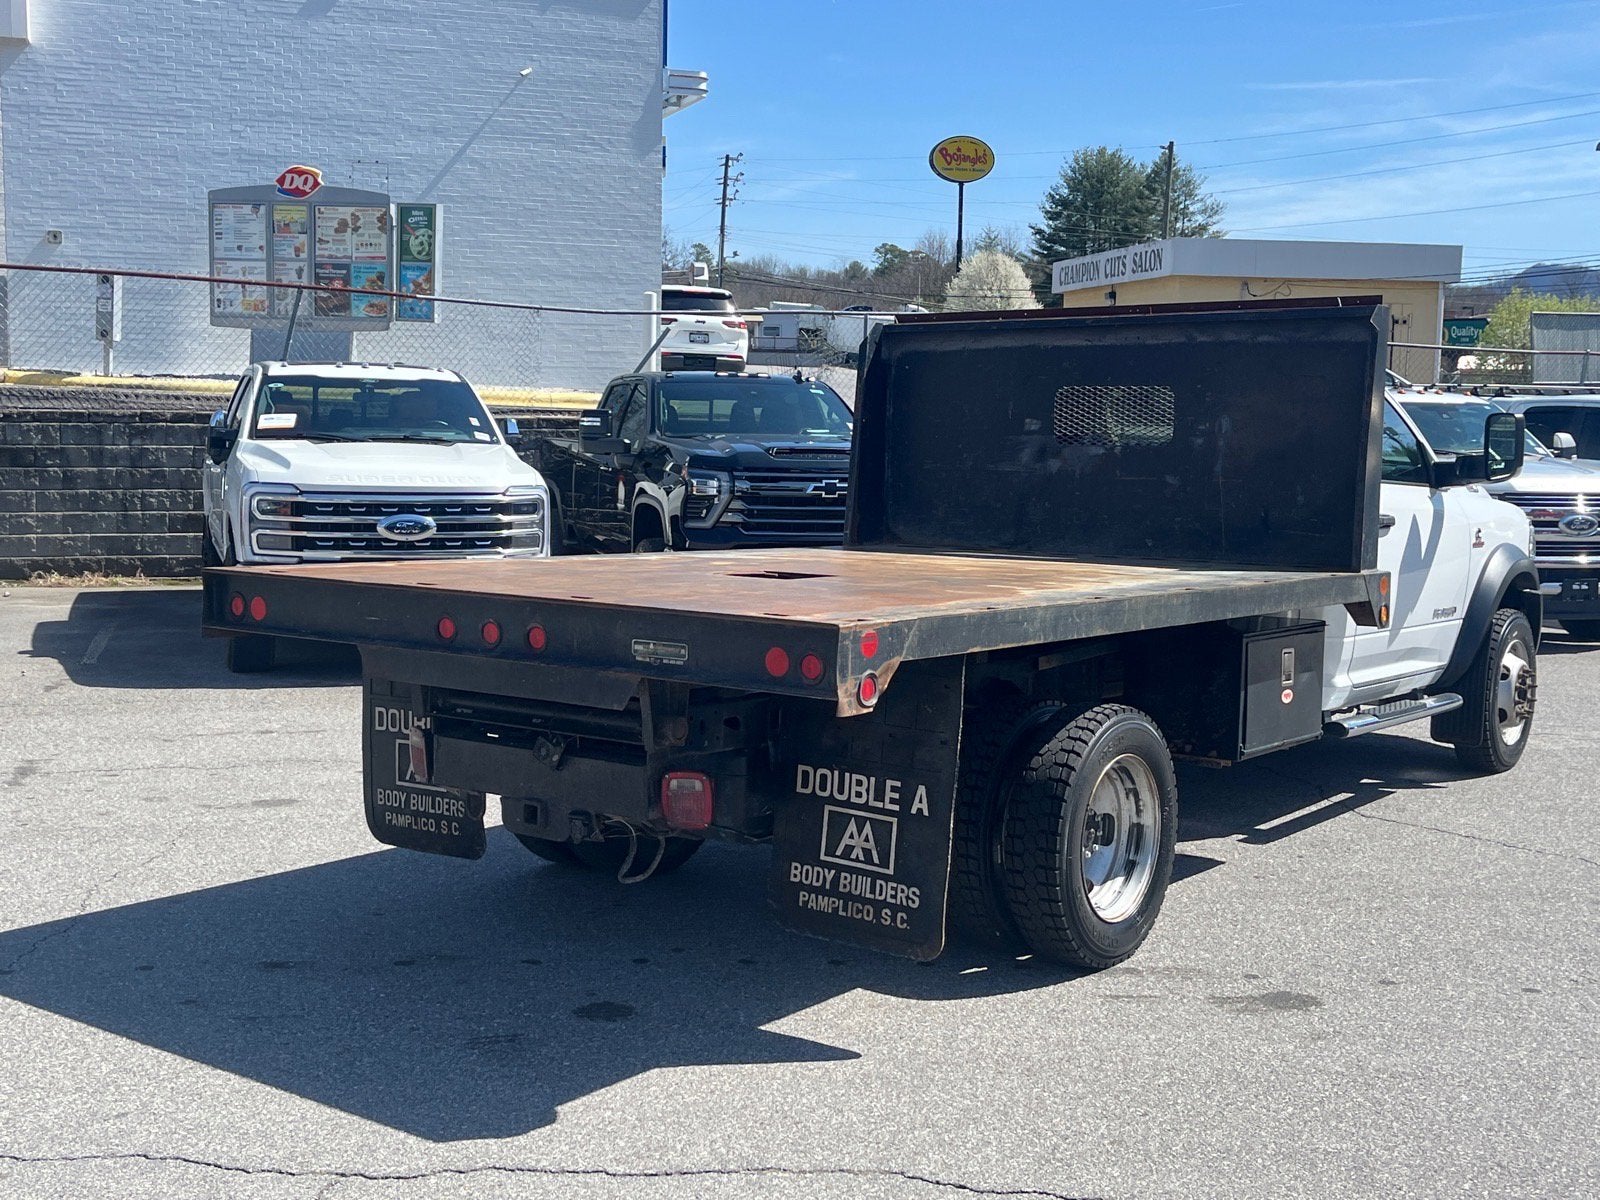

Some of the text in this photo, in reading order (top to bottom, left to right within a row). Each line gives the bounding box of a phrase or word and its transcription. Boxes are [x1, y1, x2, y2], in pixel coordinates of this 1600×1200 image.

[282, 173, 314, 193] DQ
[1060, 248, 1164, 286] CHAMPION CUTS SALON
[1450, 325, 1479, 339] Quality
[392, 520, 423, 534] Ford
[377, 788, 466, 818] BODY BUILDERS
[795, 764, 930, 817] DOUBLE A
[385, 811, 438, 834] PAMPLICO,
[789, 861, 921, 909] BODY BUILDERS
[798, 891, 877, 924] PAMPLICO,
